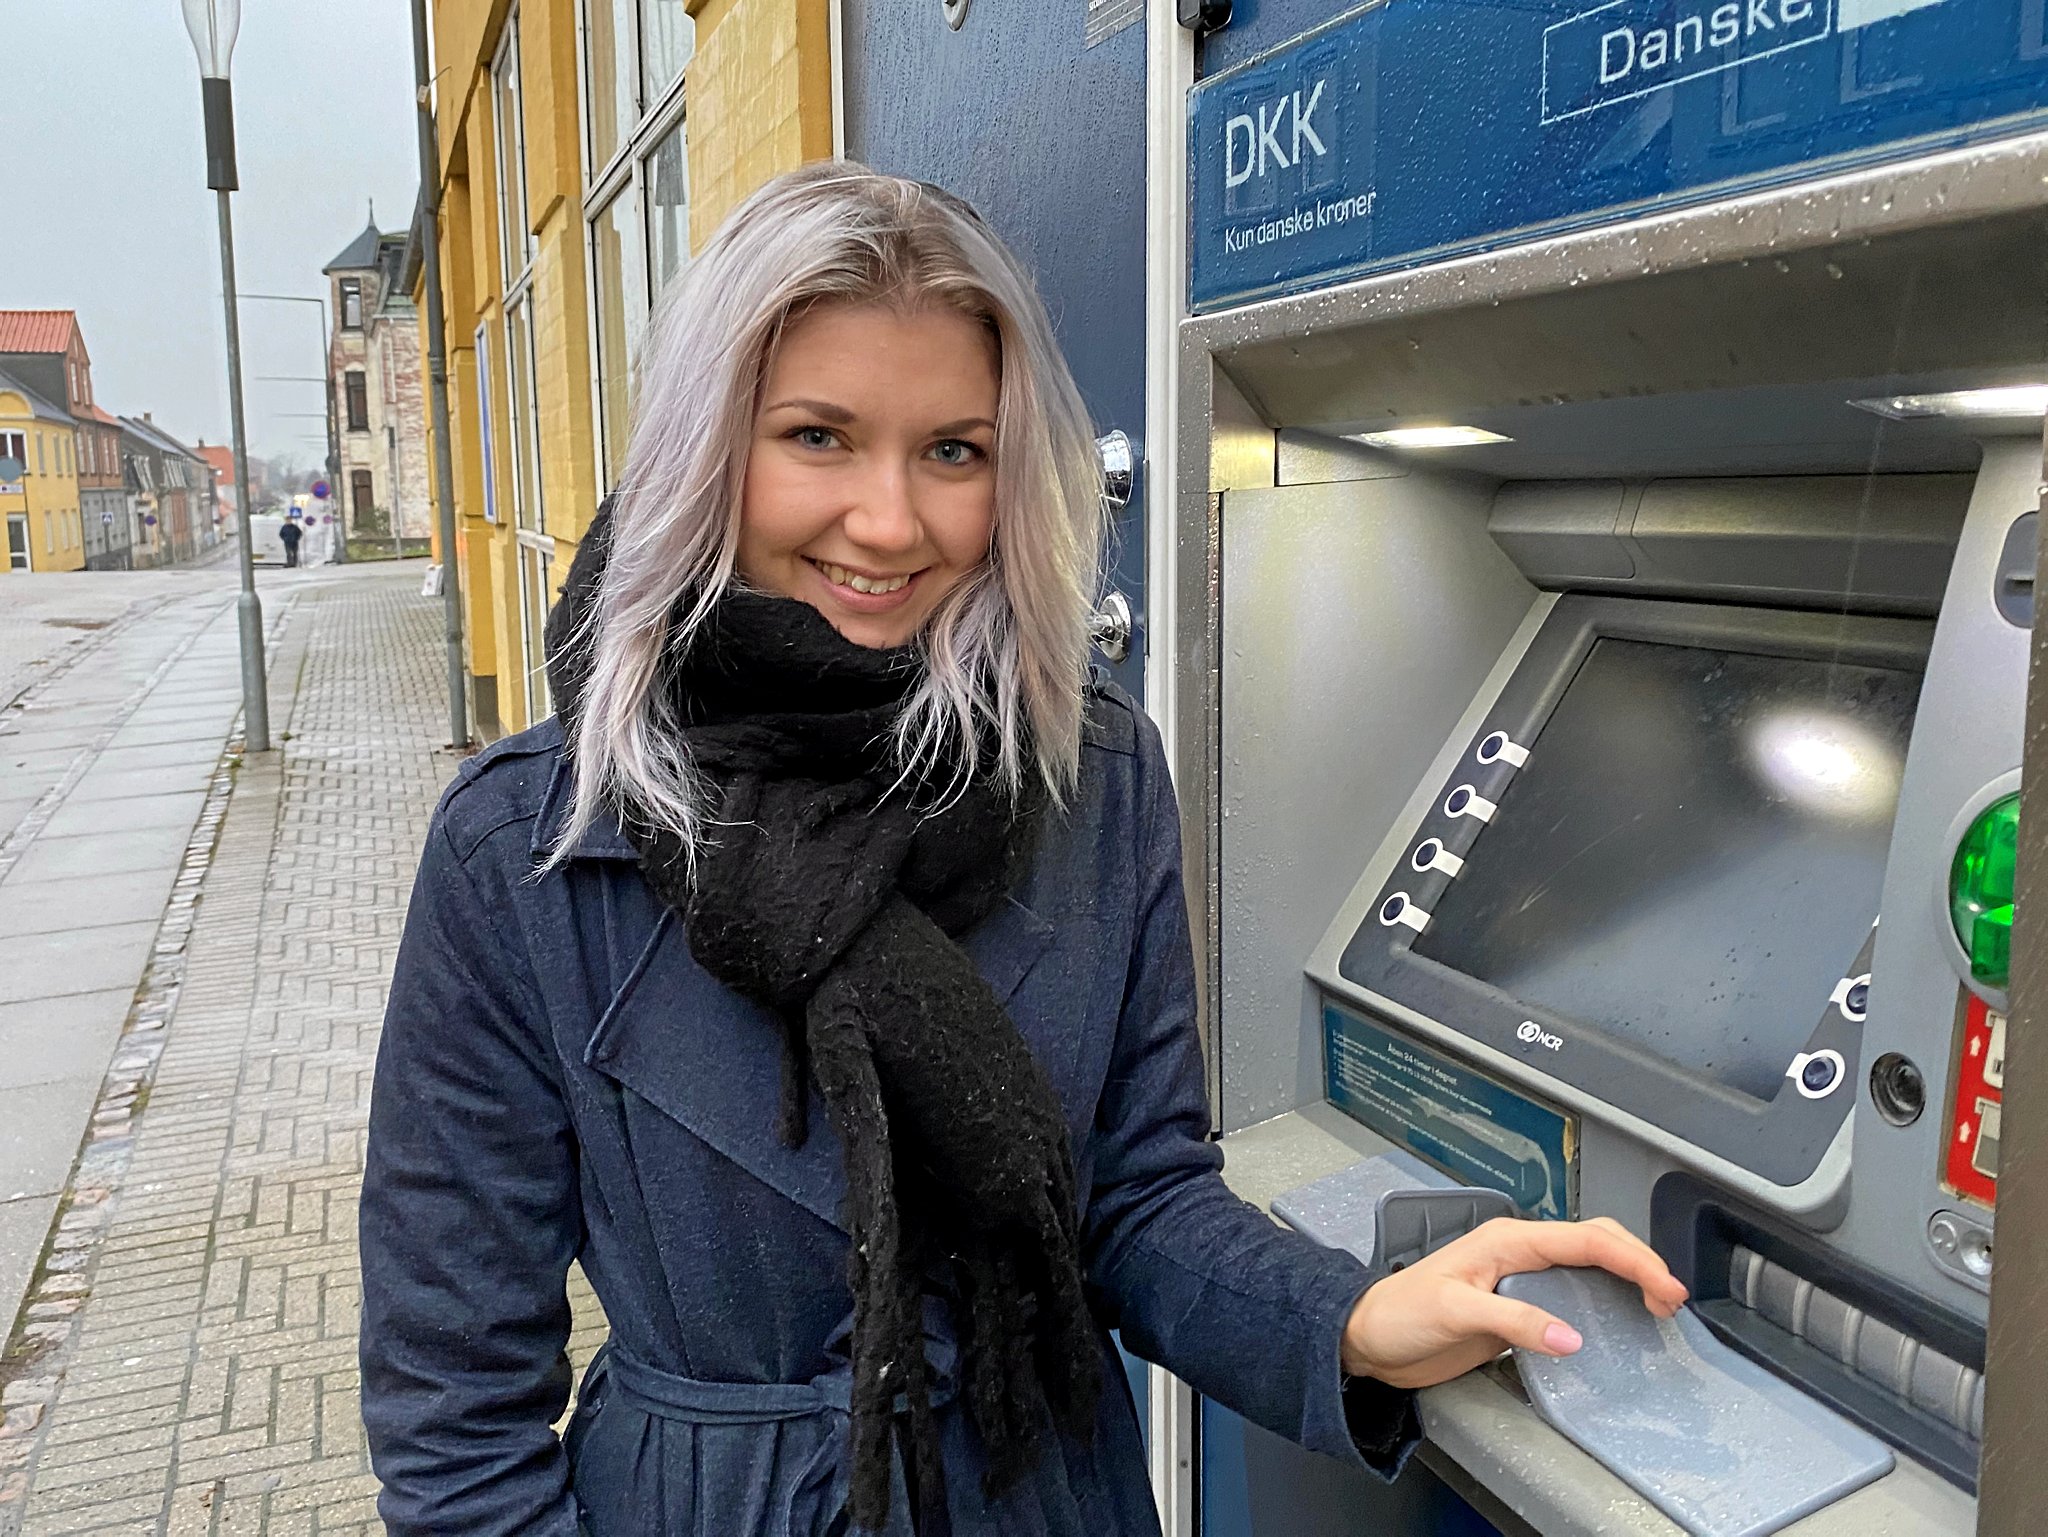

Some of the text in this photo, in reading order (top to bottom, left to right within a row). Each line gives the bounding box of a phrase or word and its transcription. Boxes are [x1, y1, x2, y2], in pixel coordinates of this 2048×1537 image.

[1600, 0, 1812, 84] Danske
[1225, 79, 1327, 189] DKK
[1225, 190, 1377, 255] Kun danske kroner
[1403, 1051, 1414, 1063] 24
[1536, 1031, 1564, 1052] NCR
